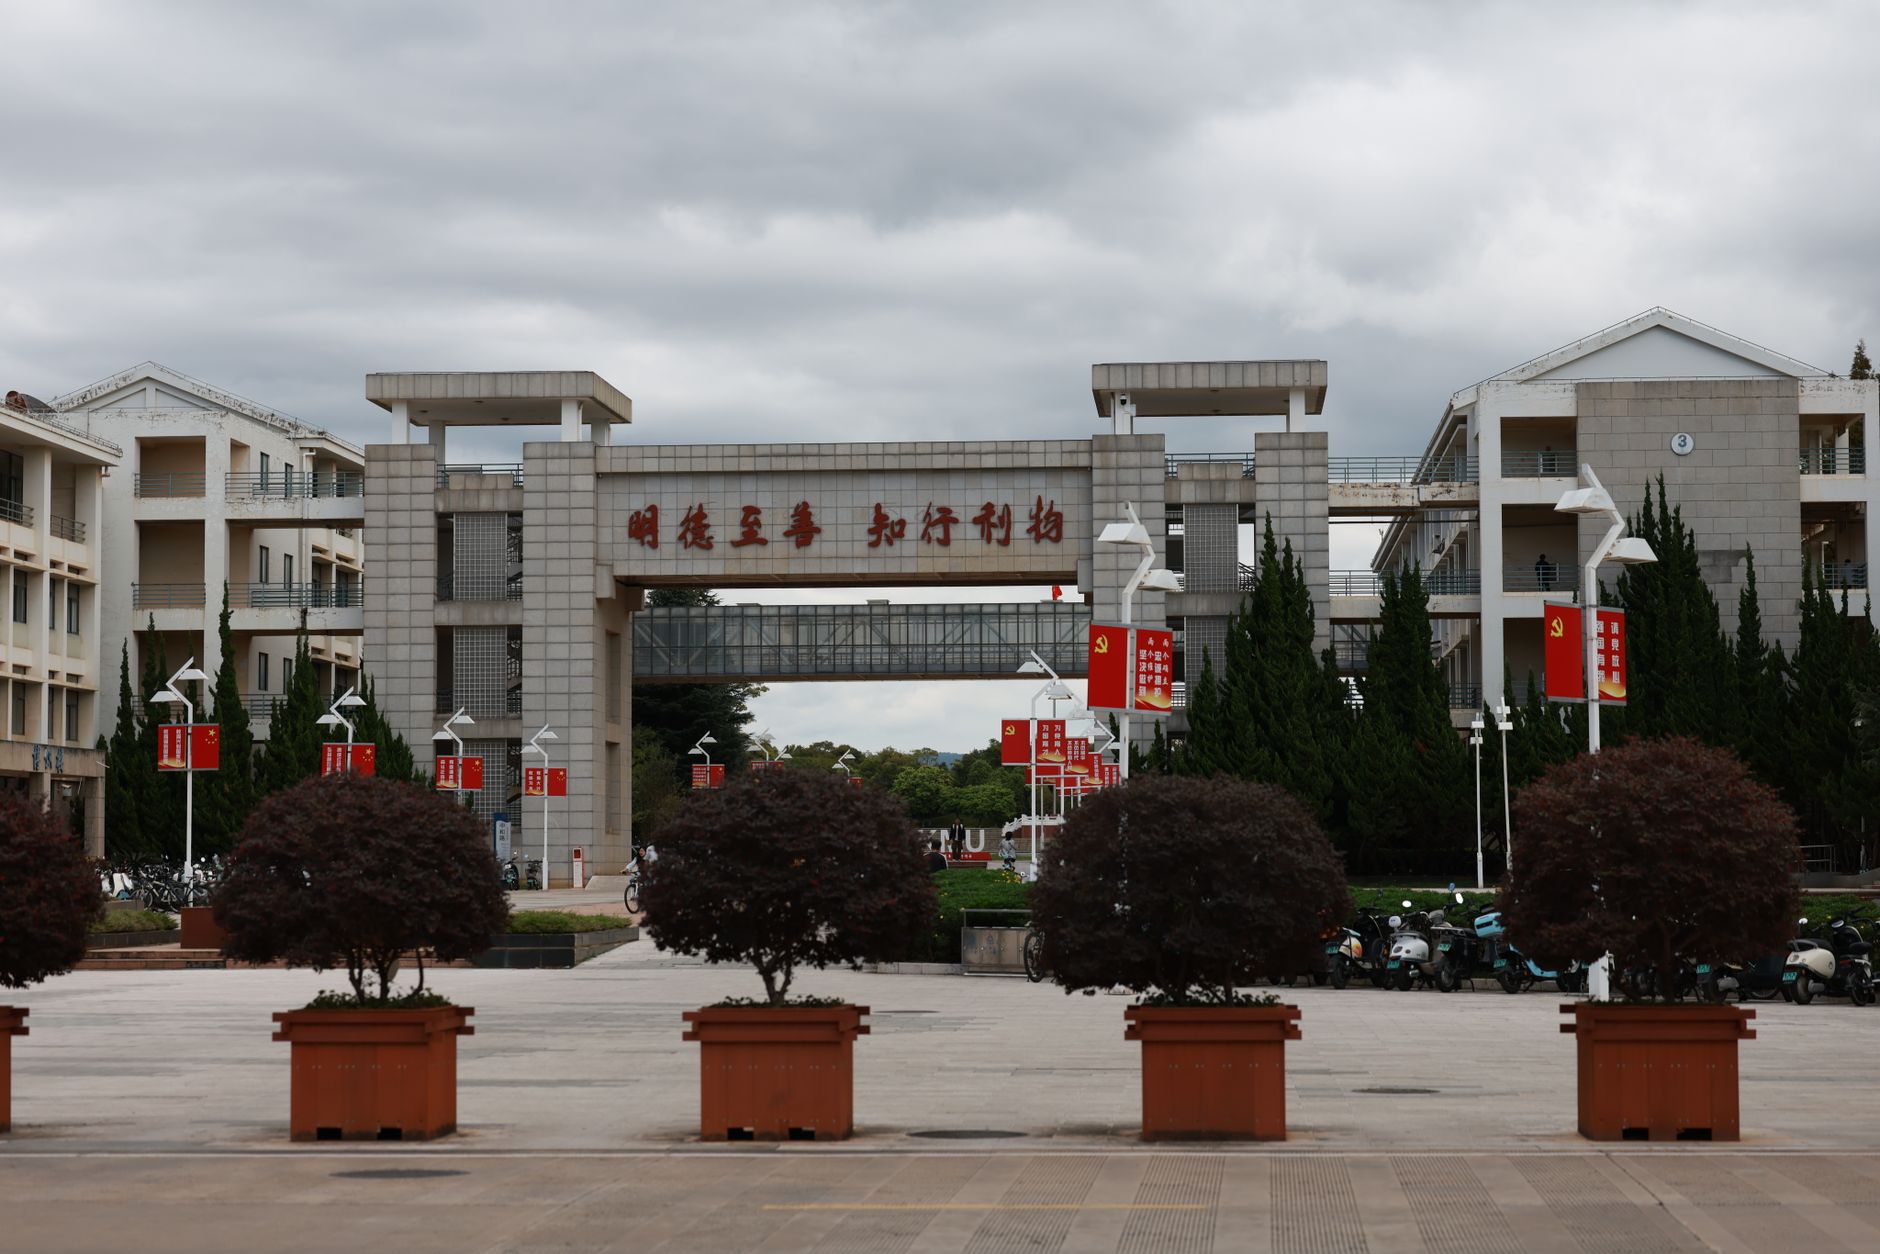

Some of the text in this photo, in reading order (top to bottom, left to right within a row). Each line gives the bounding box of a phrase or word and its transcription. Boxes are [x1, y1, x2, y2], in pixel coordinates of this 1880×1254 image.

[1677, 434, 1688, 448] 3
[627, 495, 1064, 551] 明德至善 知行利物
